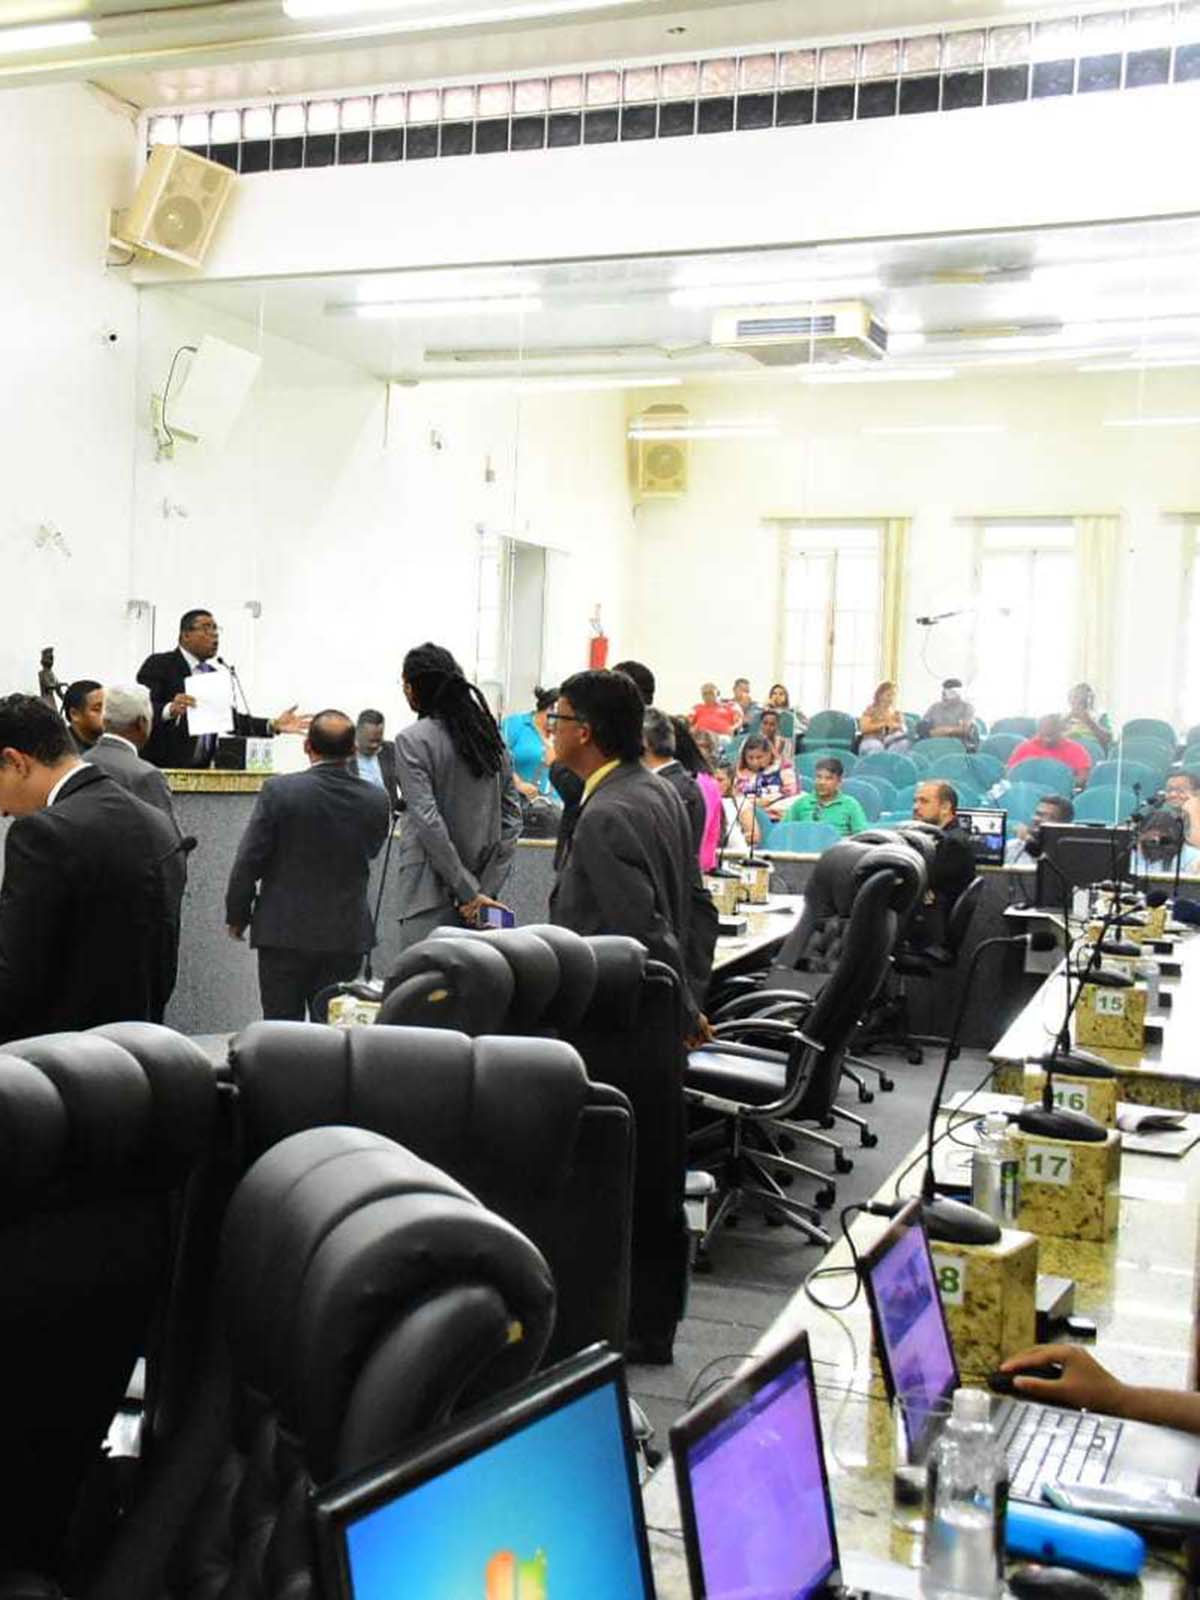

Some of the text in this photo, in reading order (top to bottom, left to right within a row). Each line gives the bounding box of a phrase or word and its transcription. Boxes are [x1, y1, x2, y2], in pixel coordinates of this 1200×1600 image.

[1099, 995, 1122, 1011] 15
[1053, 1091, 1085, 1111] 16
[1029, 1152, 1067, 1177] 17
[939, 1266, 959, 1293] 8
